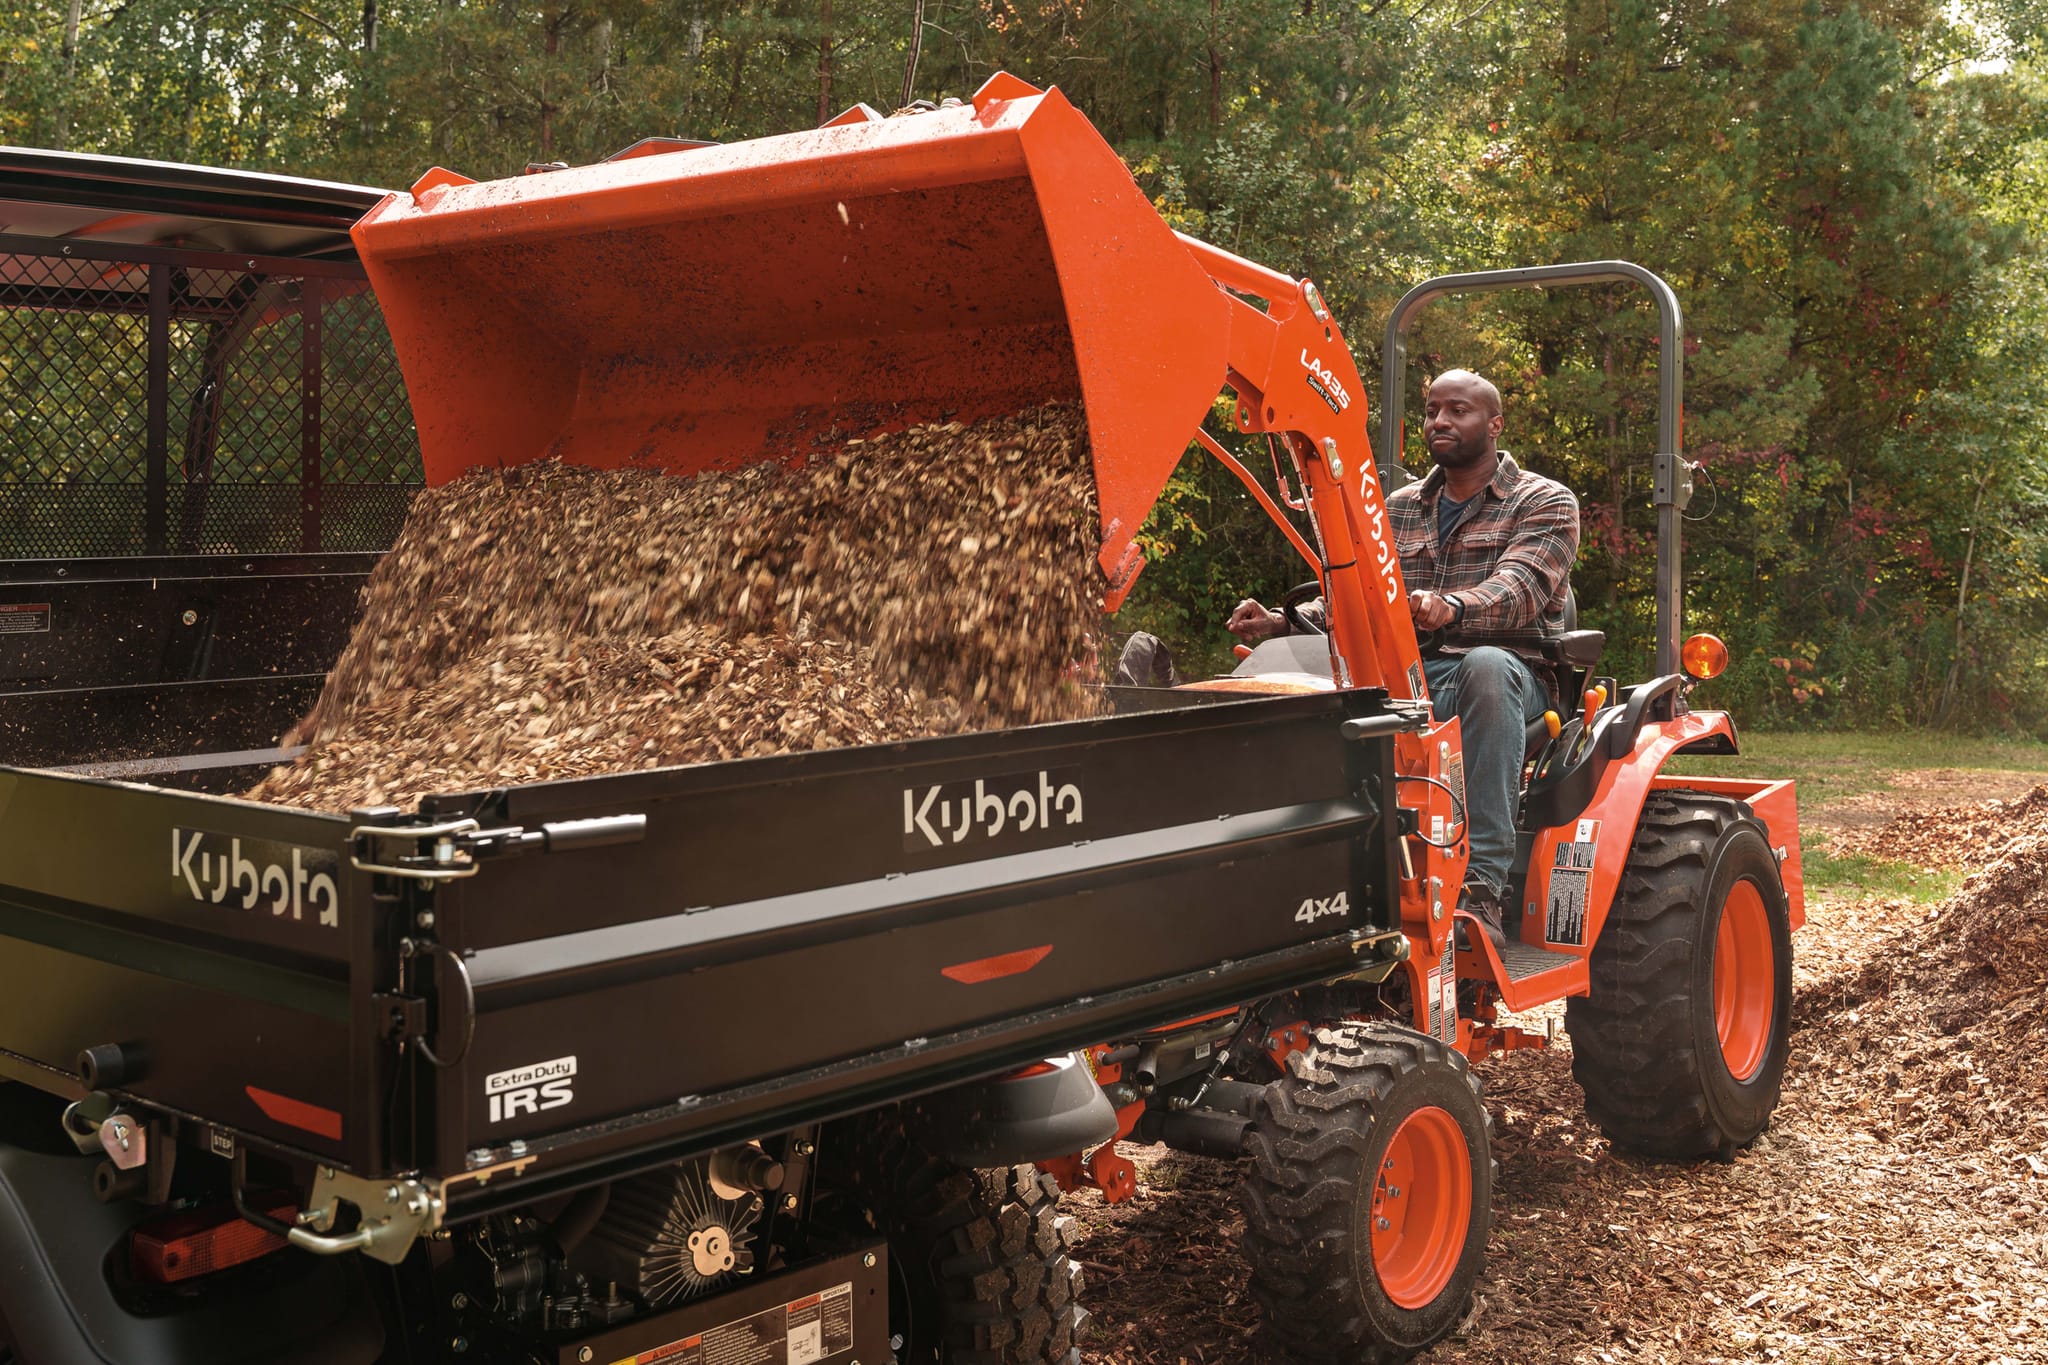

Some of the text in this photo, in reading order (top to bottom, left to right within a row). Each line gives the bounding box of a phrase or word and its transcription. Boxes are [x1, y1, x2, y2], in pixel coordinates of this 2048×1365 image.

[1300, 348, 1351, 409] LA435
[1359, 458, 1398, 605] Kubota
[904, 771, 1083, 846] Kubota
[172, 828, 338, 928] Kubota
[1294, 891, 1350, 924] 4x4
[489, 1078, 574, 1123] IRS
[213, 1135, 231, 1150] STEP
[822, 1285, 849, 1299] IMPORTANT
